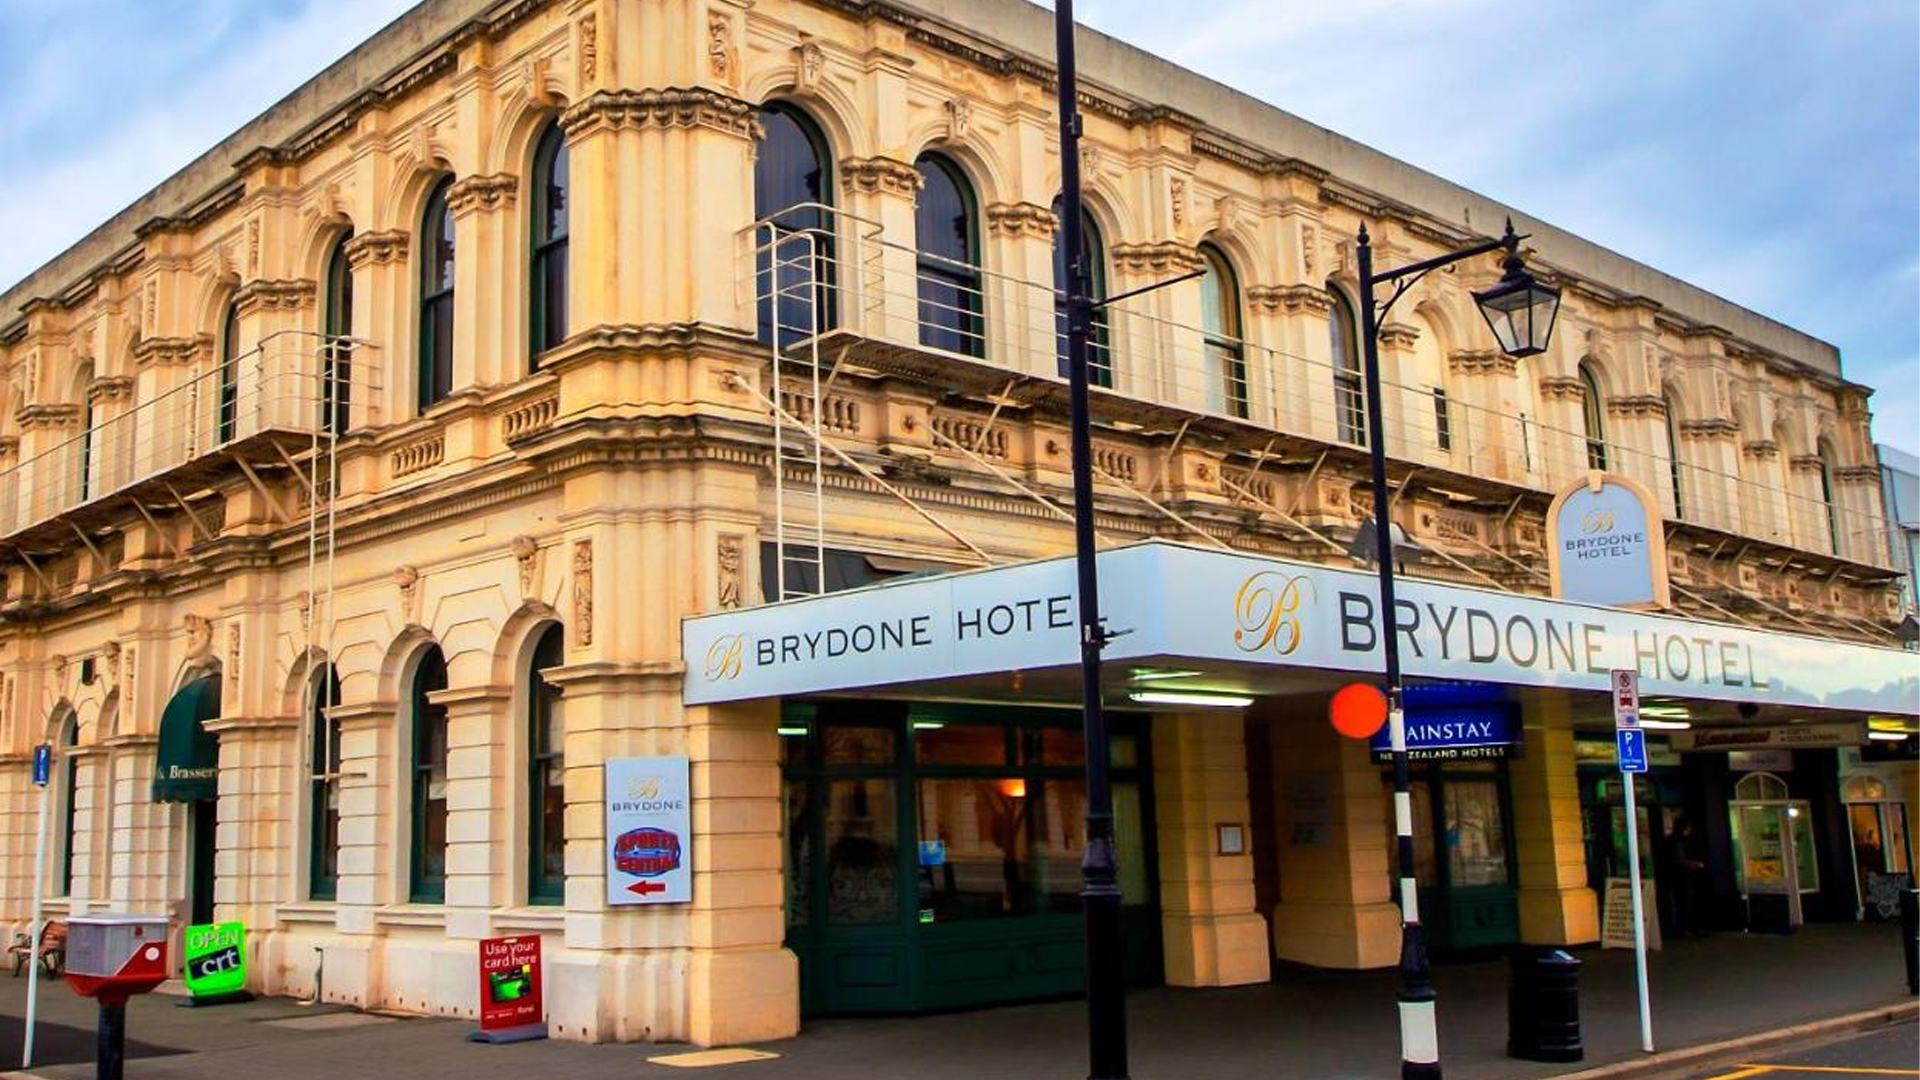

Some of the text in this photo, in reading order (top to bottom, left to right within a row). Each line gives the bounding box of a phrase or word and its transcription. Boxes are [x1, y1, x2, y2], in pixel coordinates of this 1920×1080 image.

[1565, 532, 1645, 551] BRYDONE
[1578, 546, 1632, 560] HOTEL
[757, 594, 1107, 667] BRYDONE HOTE
[1338, 590, 1770, 689] BRYDONE HOTEL
[1389, 721, 1492, 742] AINSTAY
[1408, 749, 1457, 760] ZEALAND
[1462, 747, 1504, 757] HOTELS
[612, 801, 684, 812] BRYDONE
[189, 929, 238, 950] OPEN
[485, 942, 535, 957] Use your
[201, 949, 239, 975] crt
[484, 954, 538, 968] card here
